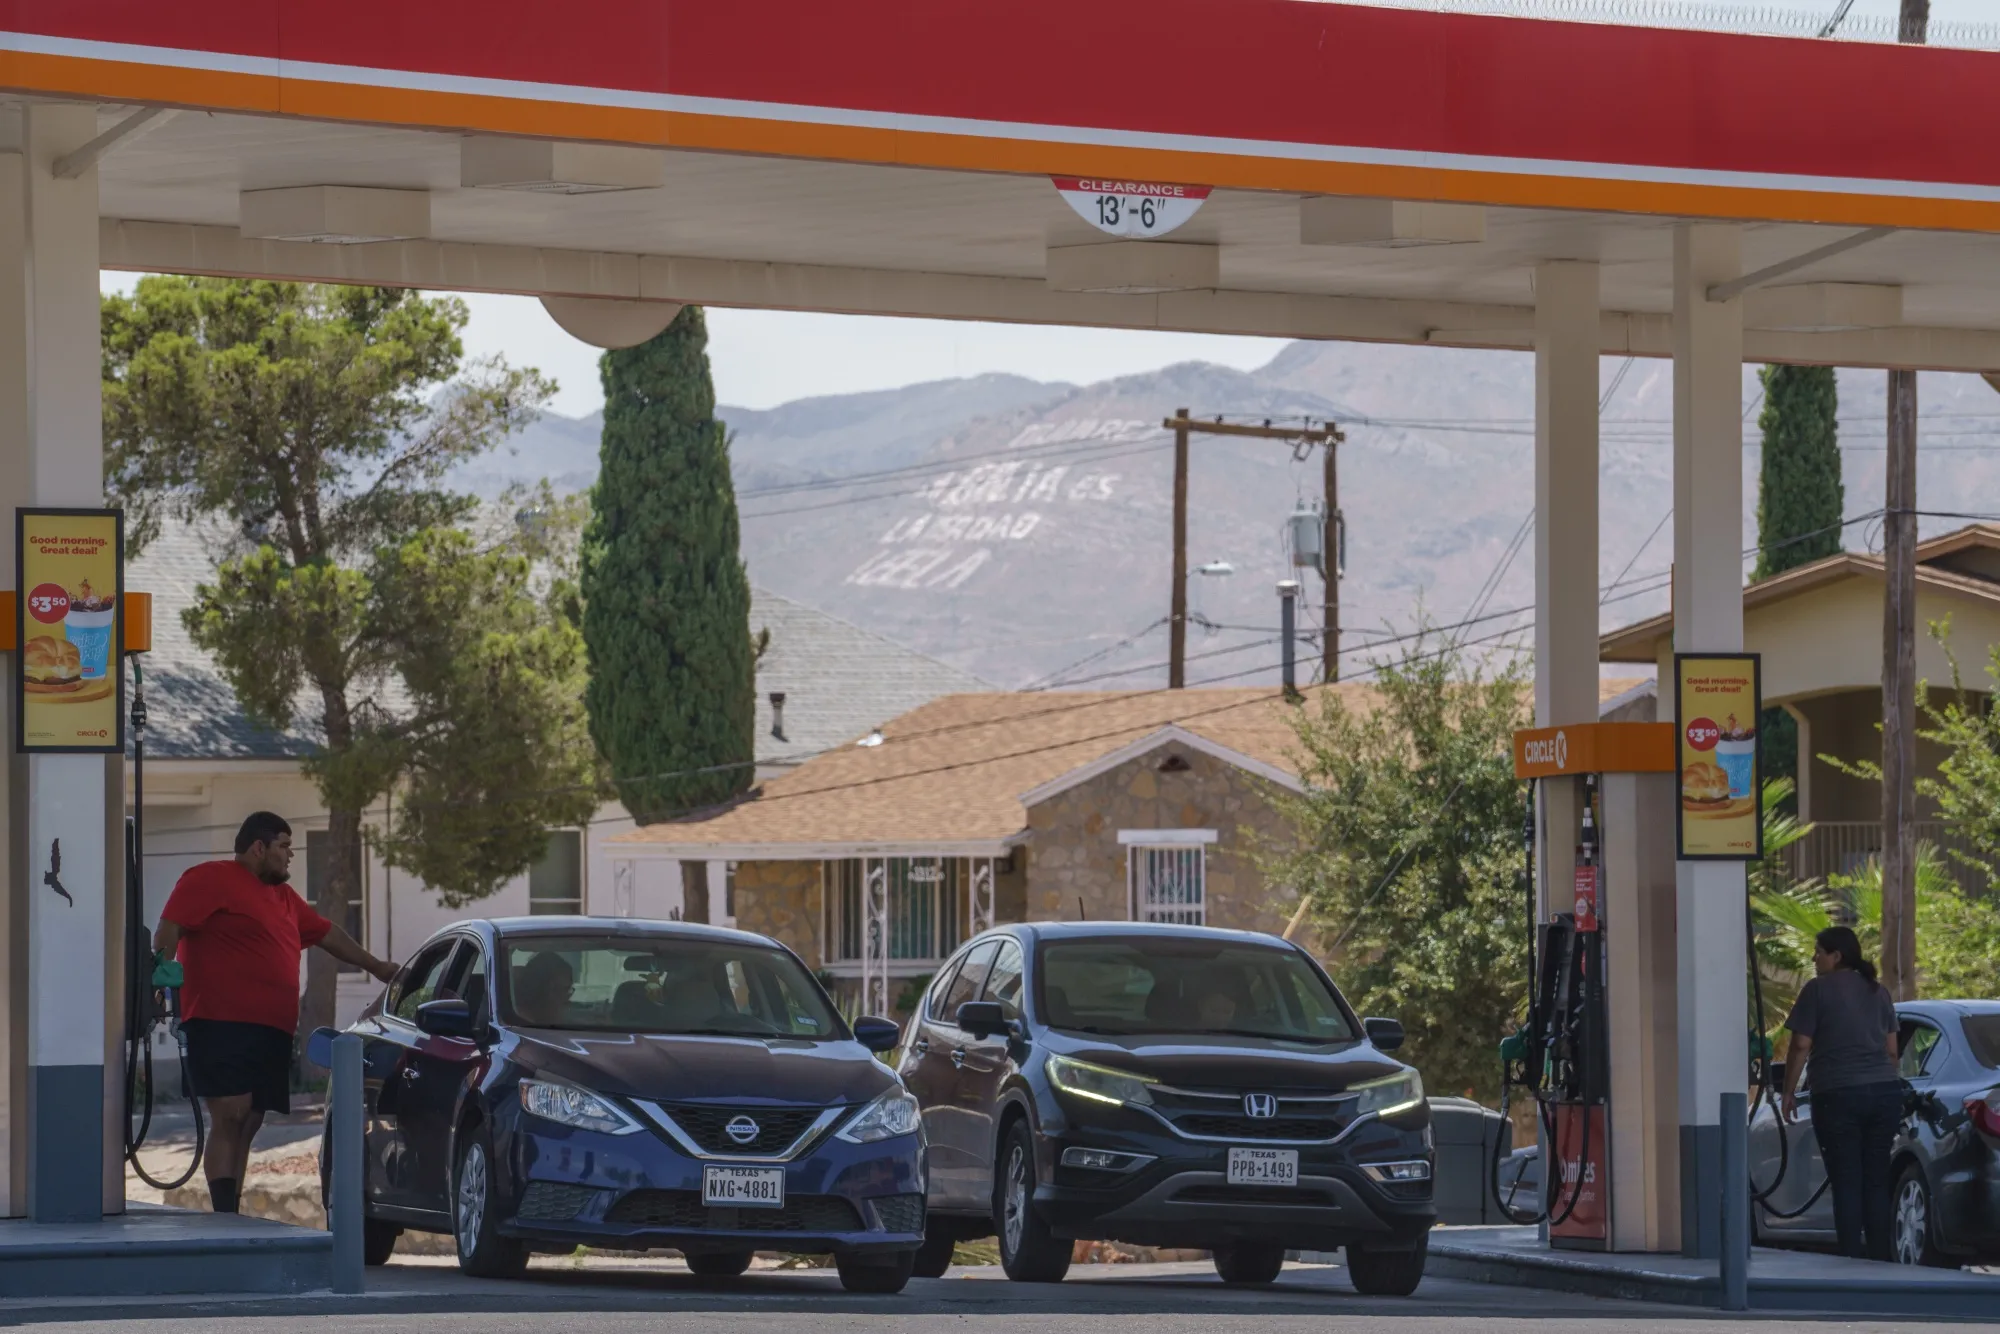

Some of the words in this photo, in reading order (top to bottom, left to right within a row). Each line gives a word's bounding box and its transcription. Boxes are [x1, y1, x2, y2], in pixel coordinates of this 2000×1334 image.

[1078, 179, 1184, 196] CLEARANCE
[1096, 196, 1165, 228] 13'-6"
[1068, 472, 1122, 500] ES
[29, 536, 58, 544] Good
[61, 536, 108, 547] morning.
[40, 546, 70, 555] Great
[71, 546, 98, 555] deal!
[1686, 677, 1710, 685] Good
[1524, 739, 1555, 764] CIRCLE
[1555, 730, 1568, 769] K
[1250, 1151, 1277, 1159] TEXAS
[730, 1168, 759, 1178] TEXAS
[1567, 1154, 1596, 1184] mies
